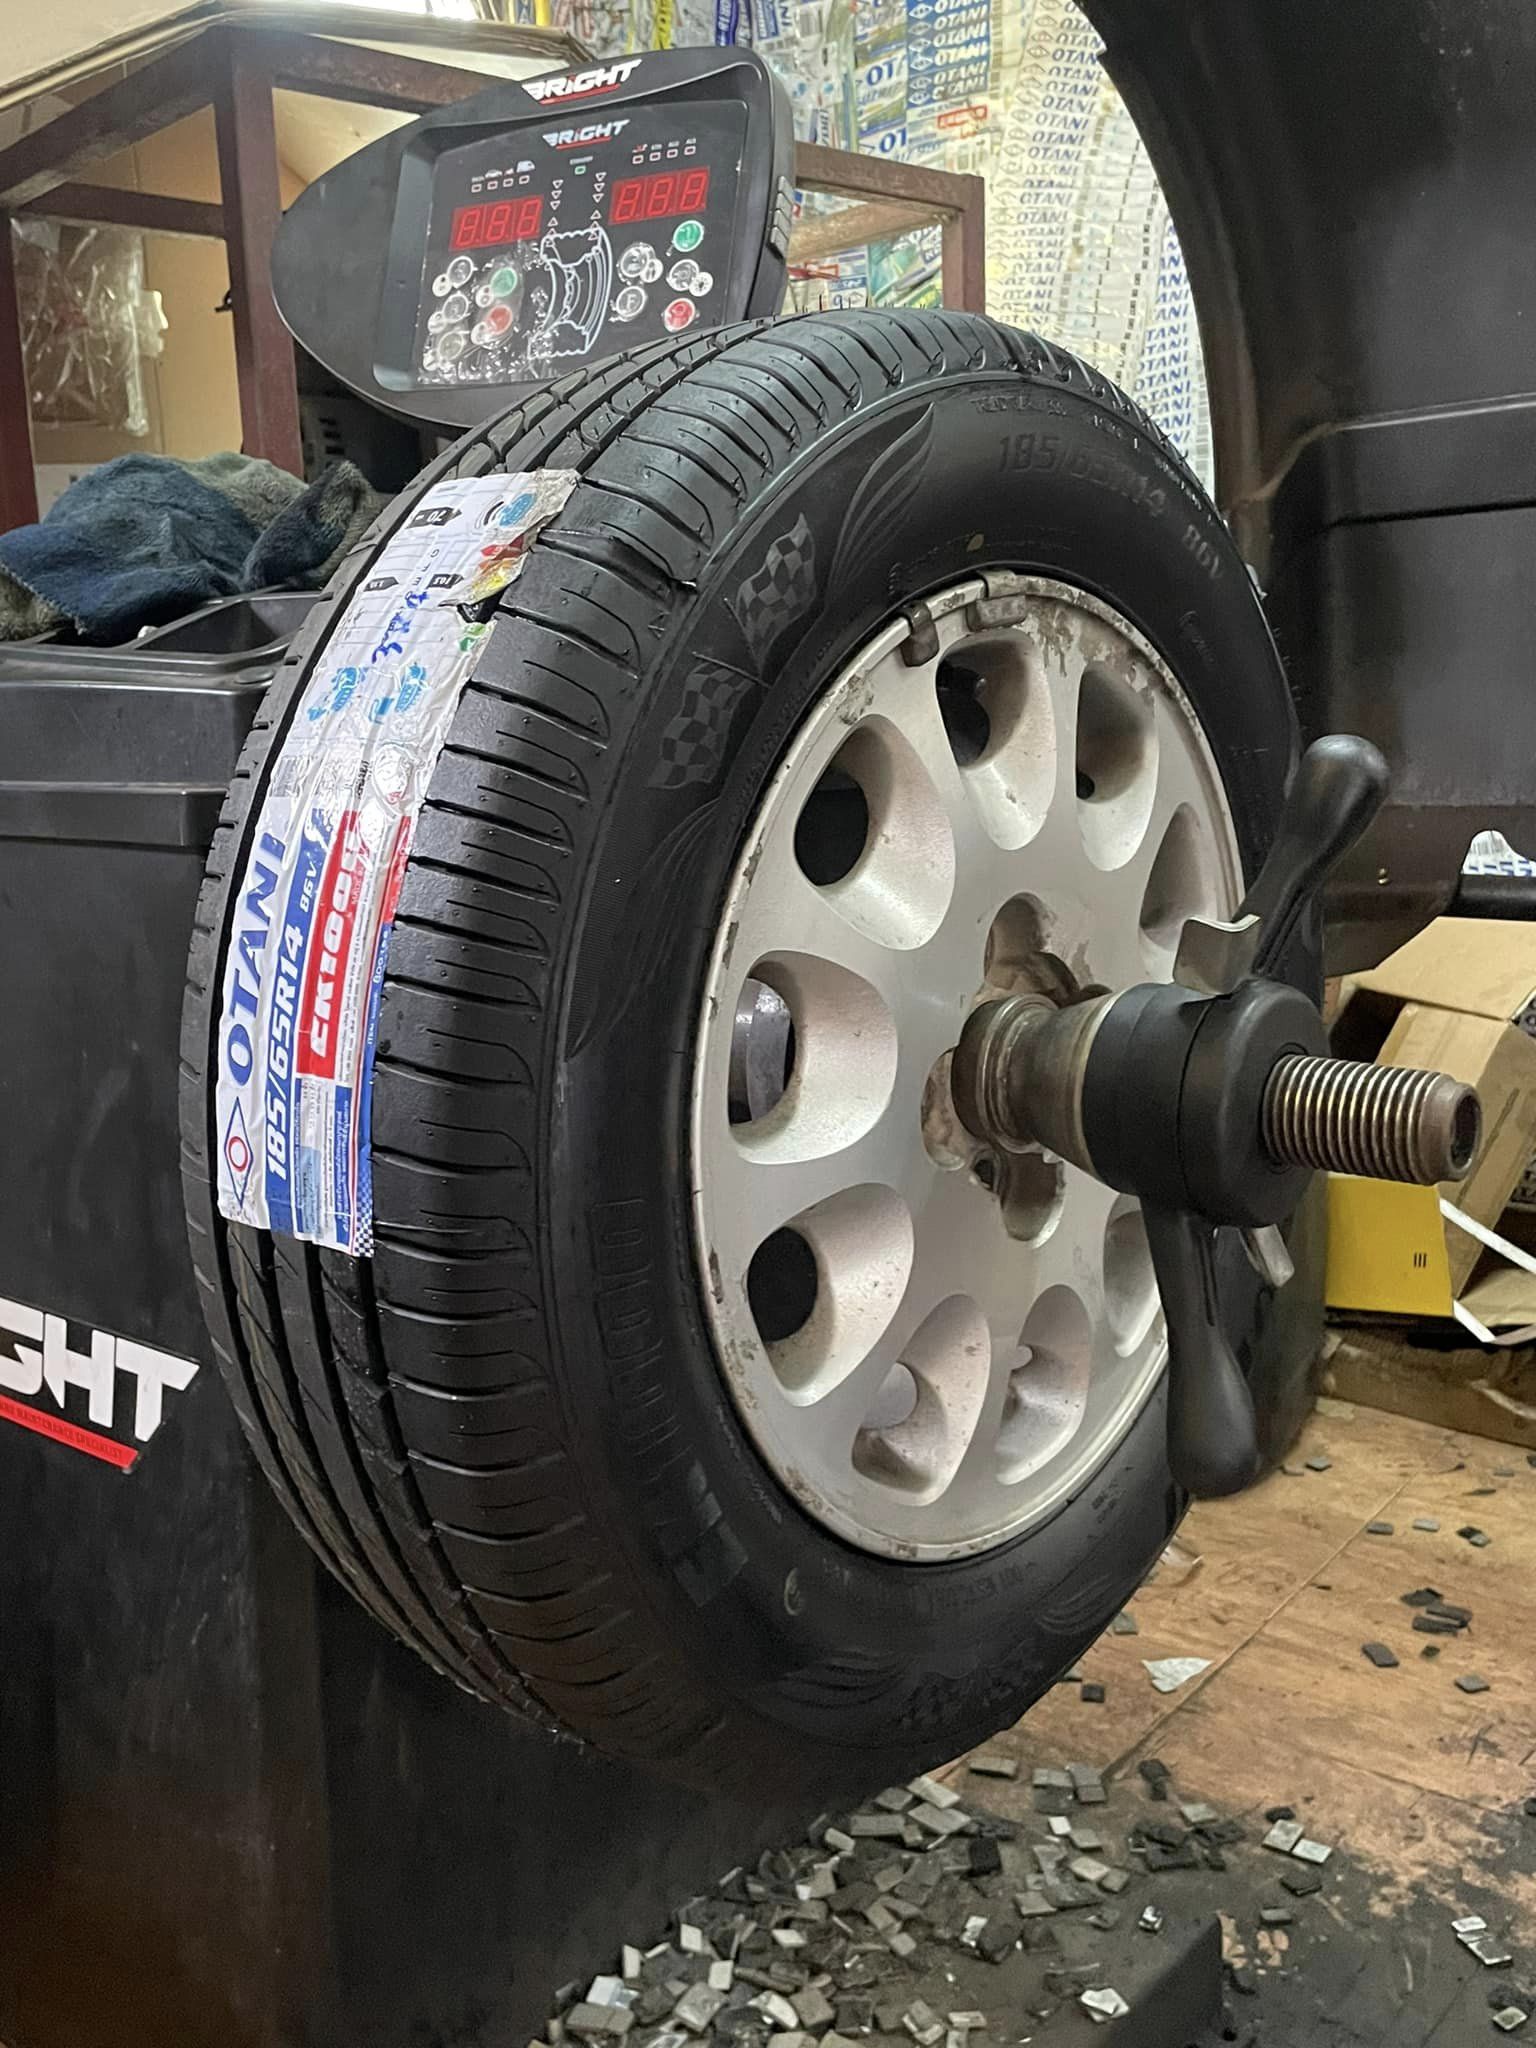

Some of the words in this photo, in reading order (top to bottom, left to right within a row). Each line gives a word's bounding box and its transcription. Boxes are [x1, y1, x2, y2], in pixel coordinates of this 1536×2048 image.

[933, 5, 987, 31] OTANI
[933, 21, 987, 47] OTANI
[934, 42, 987, 66] OTANI
[933, 62, 987, 85] OTANI
[1046, 80, 1099, 97] OTANI
[1042, 95, 1096, 114] OTANI
[1036, 112, 1089, 130] OTANI
[1032, 131, 1085, 147] OTANI
[1028, 146, 1081, 162] OTANI
[1020, 191, 1073, 206] OTANI
[1016, 210, 1069, 225] OTANI
[226, 832, 287, 1087] OTANI
[266, 923, 304, 1181] 185/65R14
[299, 860, 317, 913] 86V
